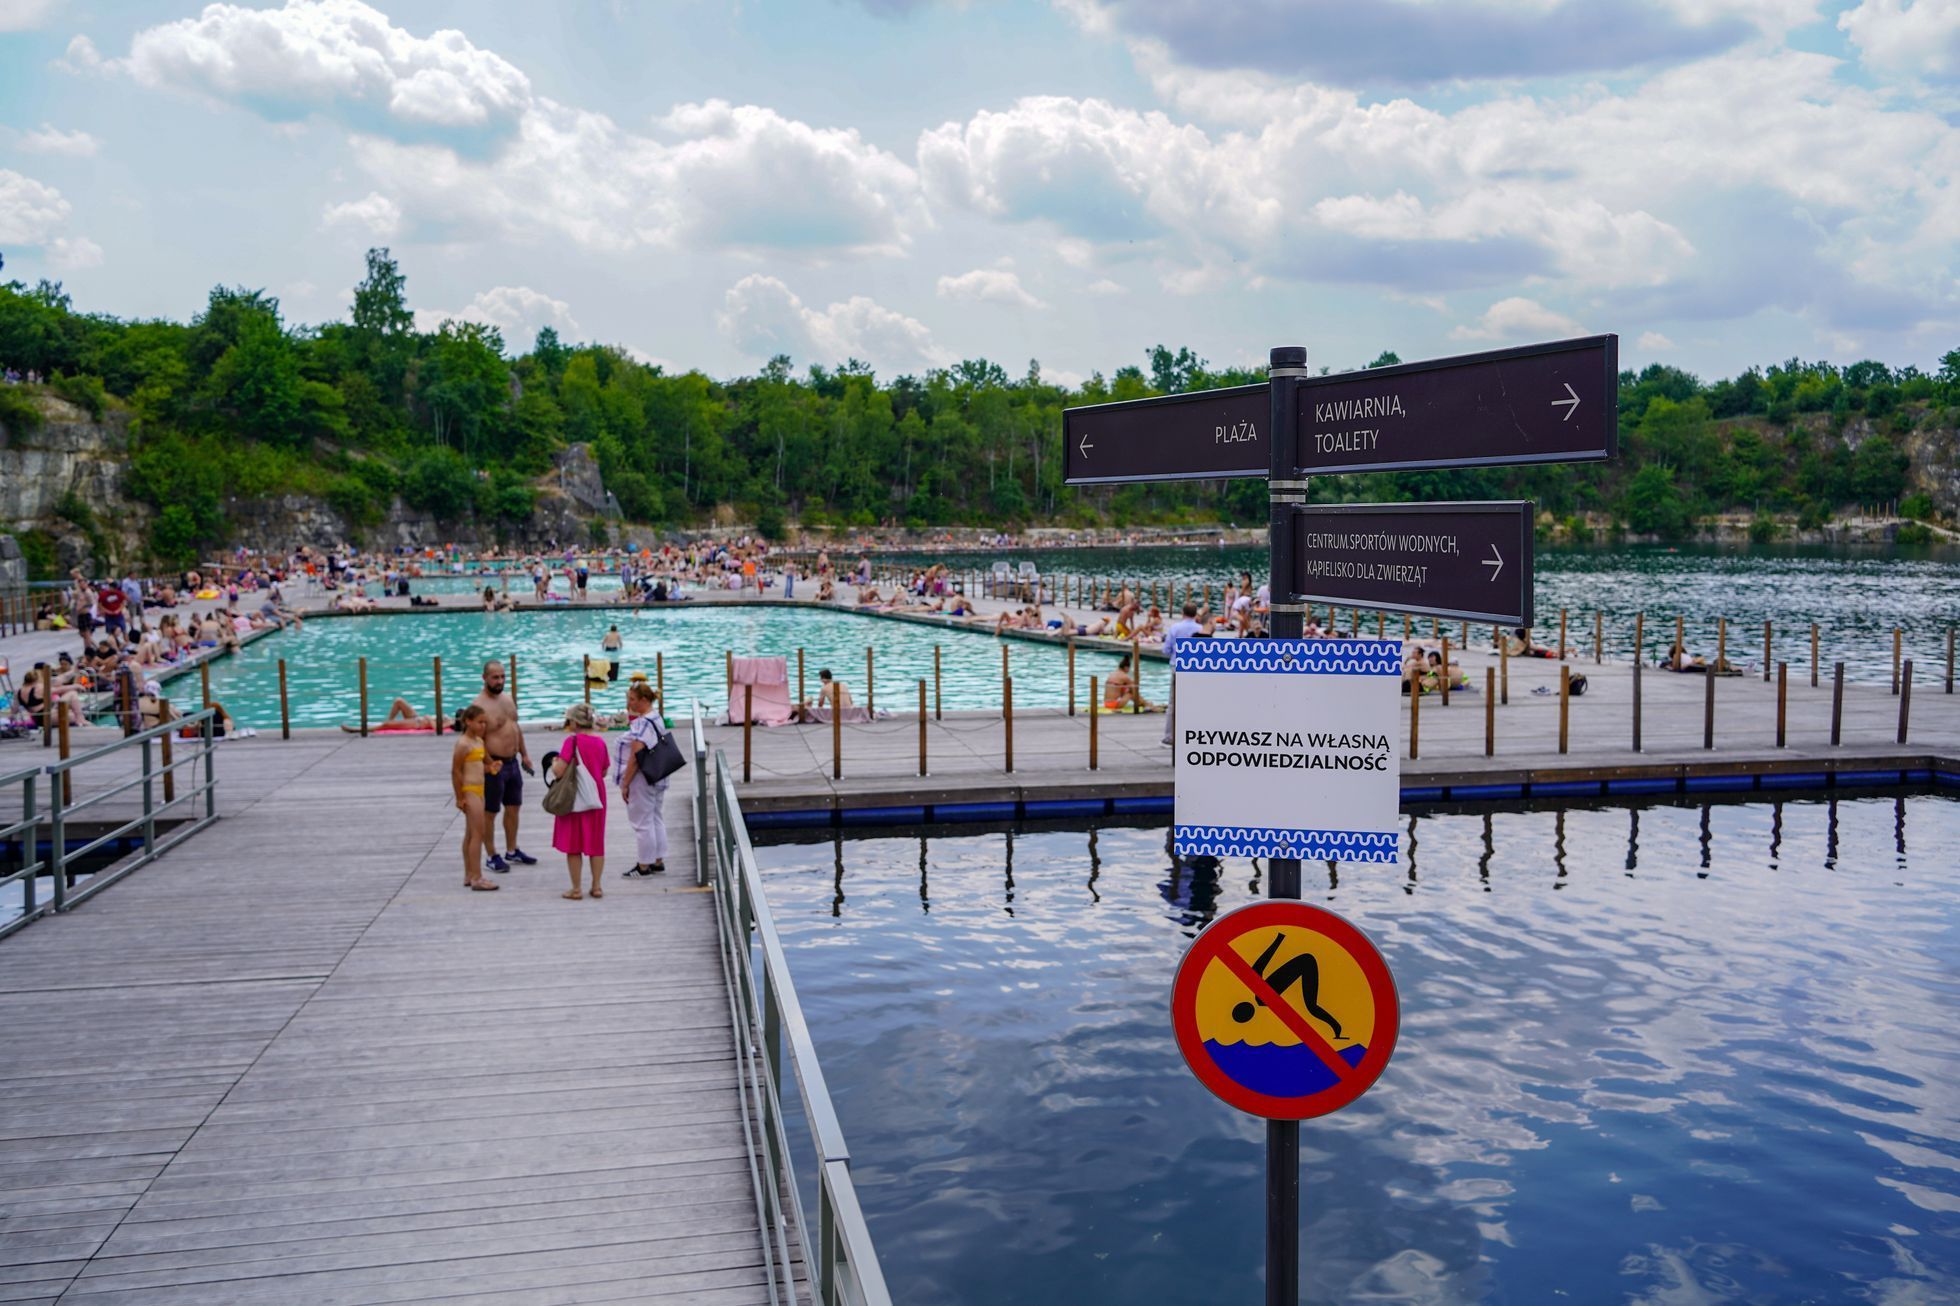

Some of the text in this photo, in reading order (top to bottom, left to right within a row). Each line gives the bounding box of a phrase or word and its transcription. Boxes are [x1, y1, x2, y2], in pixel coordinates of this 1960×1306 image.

[1315, 394, 1406, 423] KAWIARNIA,
[1215, 419, 1257, 444] PLAŻA
[1315, 429, 1380, 453] TOALETY
[1349, 530, 1397, 551] SPORTÓW
[1399, 535, 1460, 557] WODNYCH,
[1307, 560, 1428, 588] KĄPIELISKO DLA ZWIERZĄT
[1185, 730, 1390, 752] PŁYWASZ NA WŁASNĄ
[1187, 751, 1388, 771] ODPOWIEDZIALNOŚĆ
